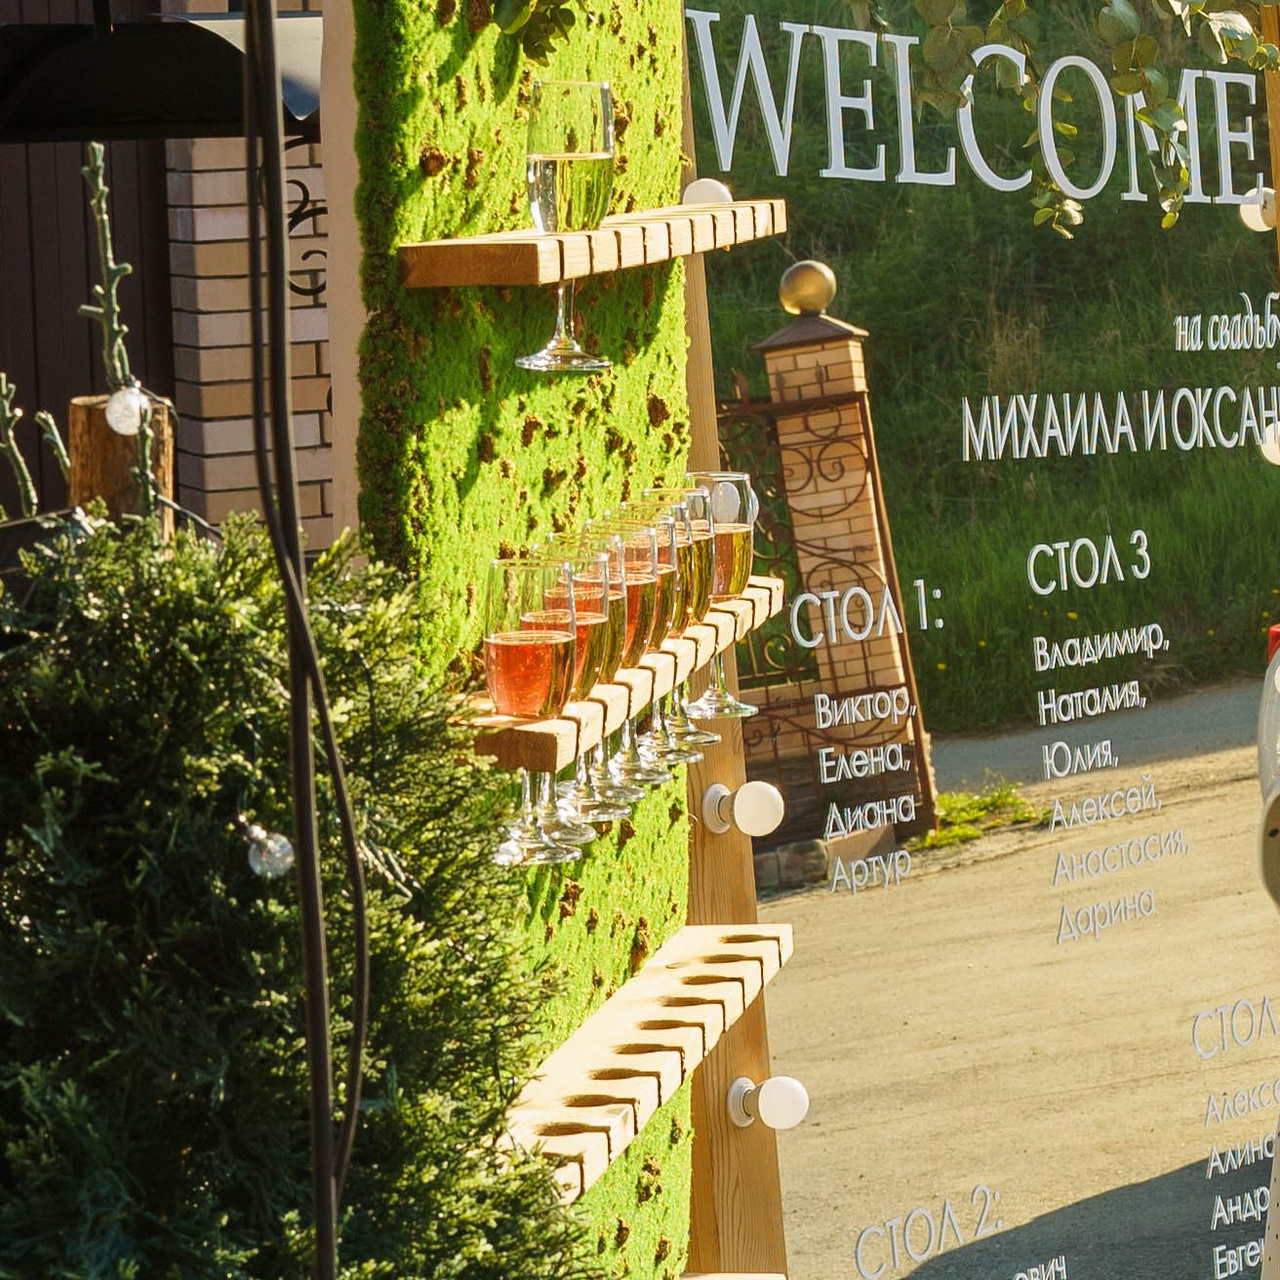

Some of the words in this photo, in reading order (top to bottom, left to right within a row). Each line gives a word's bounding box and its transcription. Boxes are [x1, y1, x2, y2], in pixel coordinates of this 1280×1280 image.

[684, 8, 1264, 205] WELCOME
[1173, 312, 1204, 352] на
[962, 390, 1138, 462] МИХАИЛА
[1141, 389, 1168, 452] И
[1026, 535, 1125, 596] СТОЛ
[1129, 528, 1152, 580] 3
[789, 584, 904, 649] СТОЛ
[912, 578, 945, 631] 1:
[1032, 622, 1171, 672] Владимир,
[813, 685, 918, 730] Виктор,
[1037, 679, 1148, 727] Наталия,
[818, 742, 912, 785] Елена,
[1041, 739, 1120, 781] Юлия,
[823, 794, 917, 845] Диана
[1049, 773, 1164, 834] Алексей,
[830, 849, 913, 896] Артур
[1053, 828, 1192, 888] Анастасия,
[1057, 889, 1156, 946] Дарина
[1192, 993, 1280, 1060] СТОЛ
[855, 1199, 965, 1280] СТОЛ
[970, 1183, 1004, 1238] 2:
[1210, 1185, 1271, 1231] Андр
